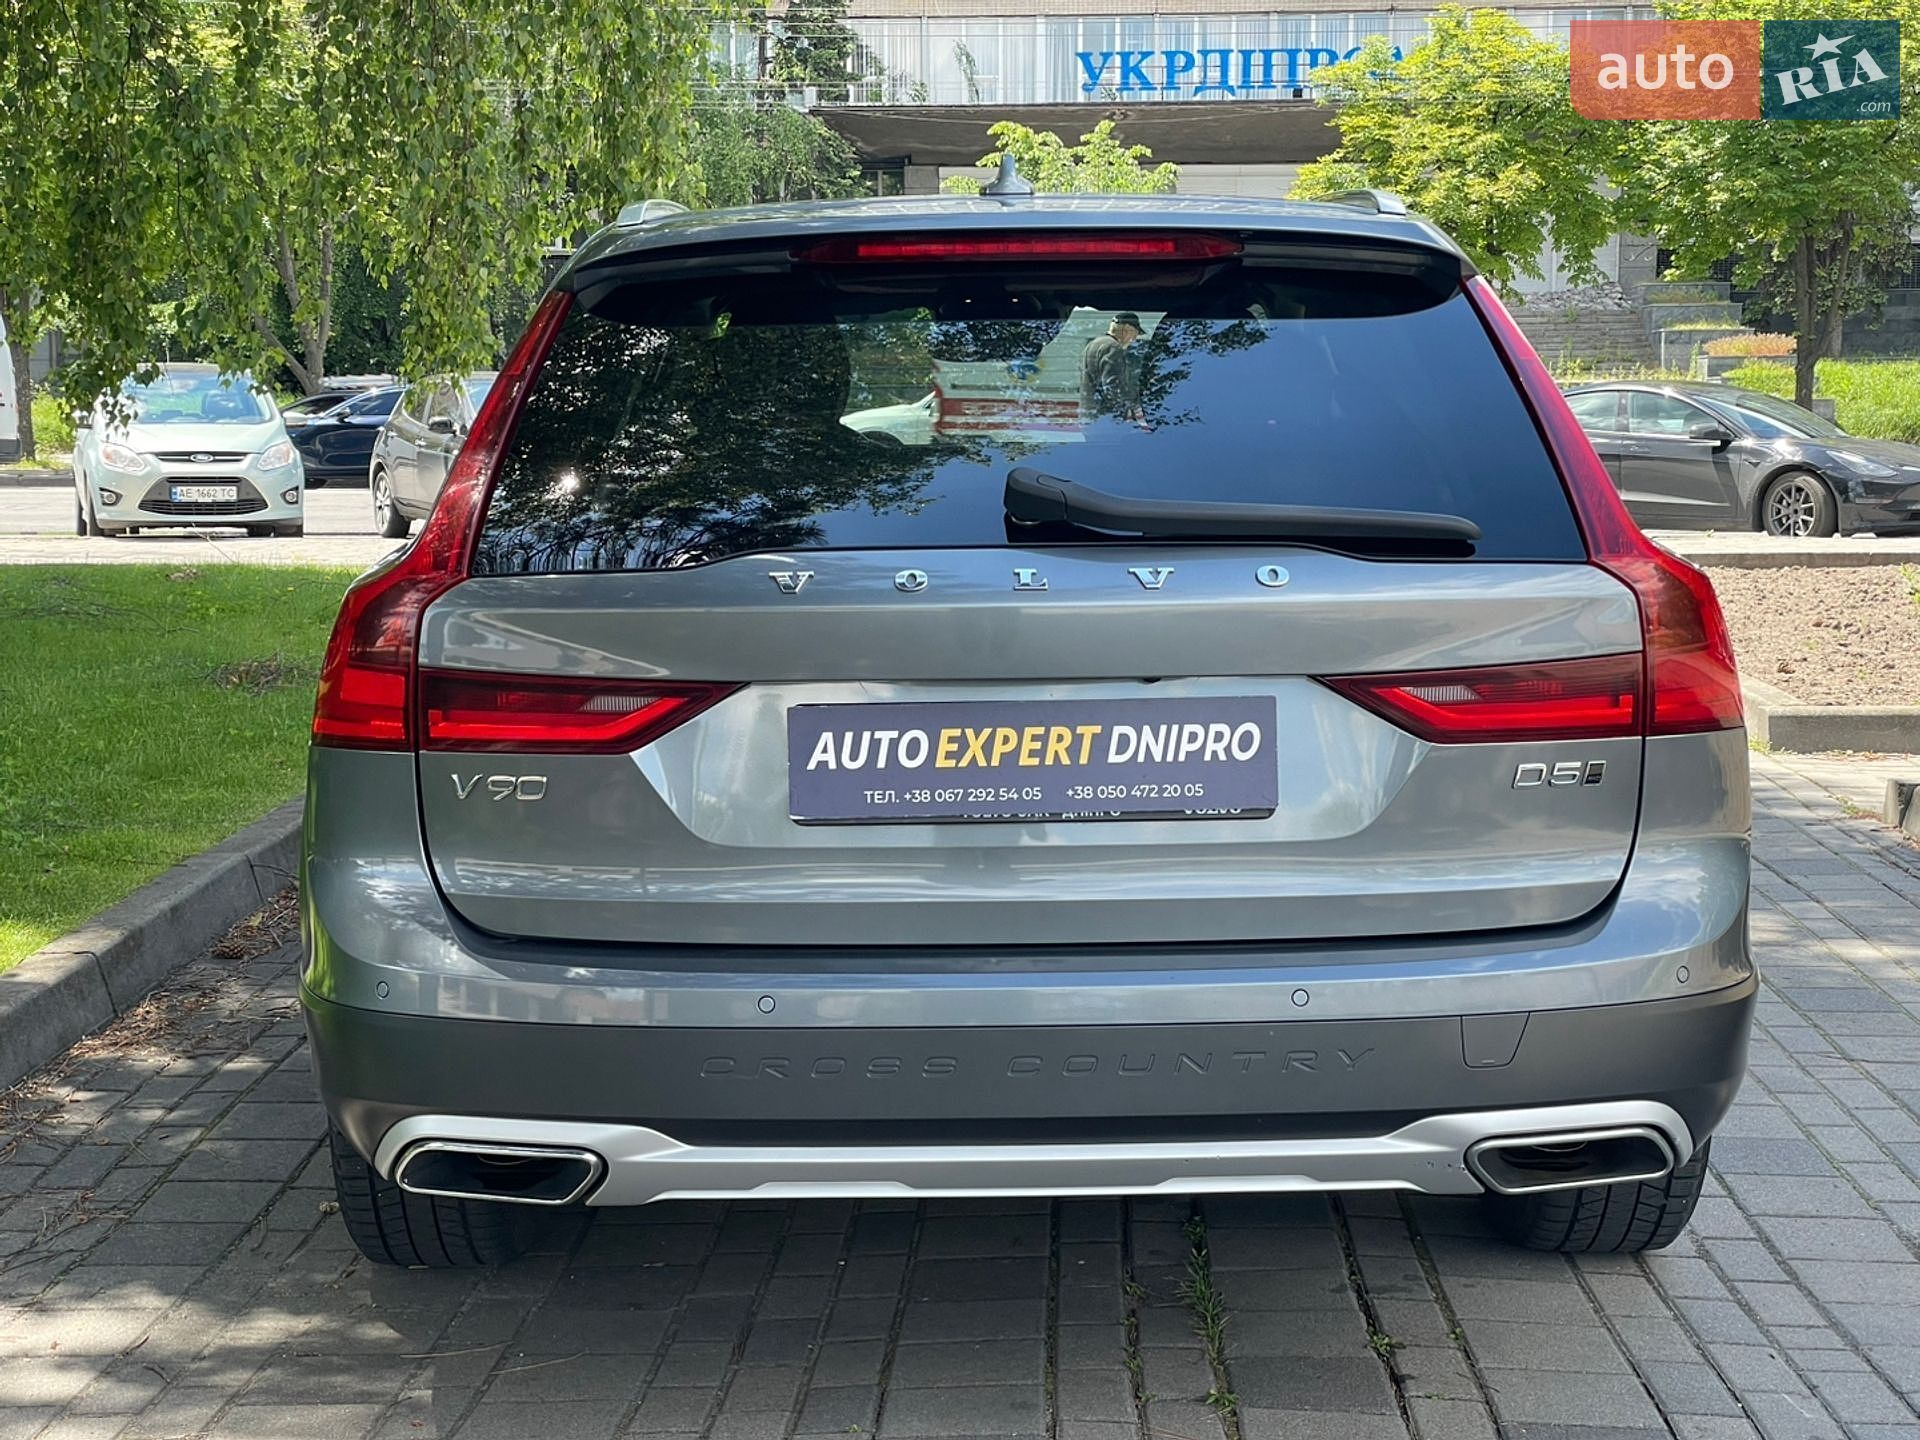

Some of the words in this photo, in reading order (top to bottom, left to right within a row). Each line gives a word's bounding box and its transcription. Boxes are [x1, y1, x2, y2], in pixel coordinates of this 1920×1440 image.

[221, 488, 235, 498] TC
[769, 565, 1290, 594] VOLVO
[806, 728, 929, 770] AUTO
[934, 725, 1102, 768] EXPERT
[1106, 721, 1261, 764] DNIPRO
[864, 790, 899, 803] ТЕЛ.
[904, 789, 930, 802] +38
[934, 789, 963, 802] 067
[967, 788, 995, 801] 292
[999, 787, 1019, 800] 54
[1022, 787, 1042, 800] 05
[1066, 785, 1093, 799] +38
[1097, 785, 1127, 799] 050
[1131, 784, 1158, 798] 472
[1162, 784, 1181, 797] 20
[1184, 783, 1204, 796] 05
[700, 1055, 959, 1079] CROSS
[1006, 1048, 1377, 1078] COUNTRY
